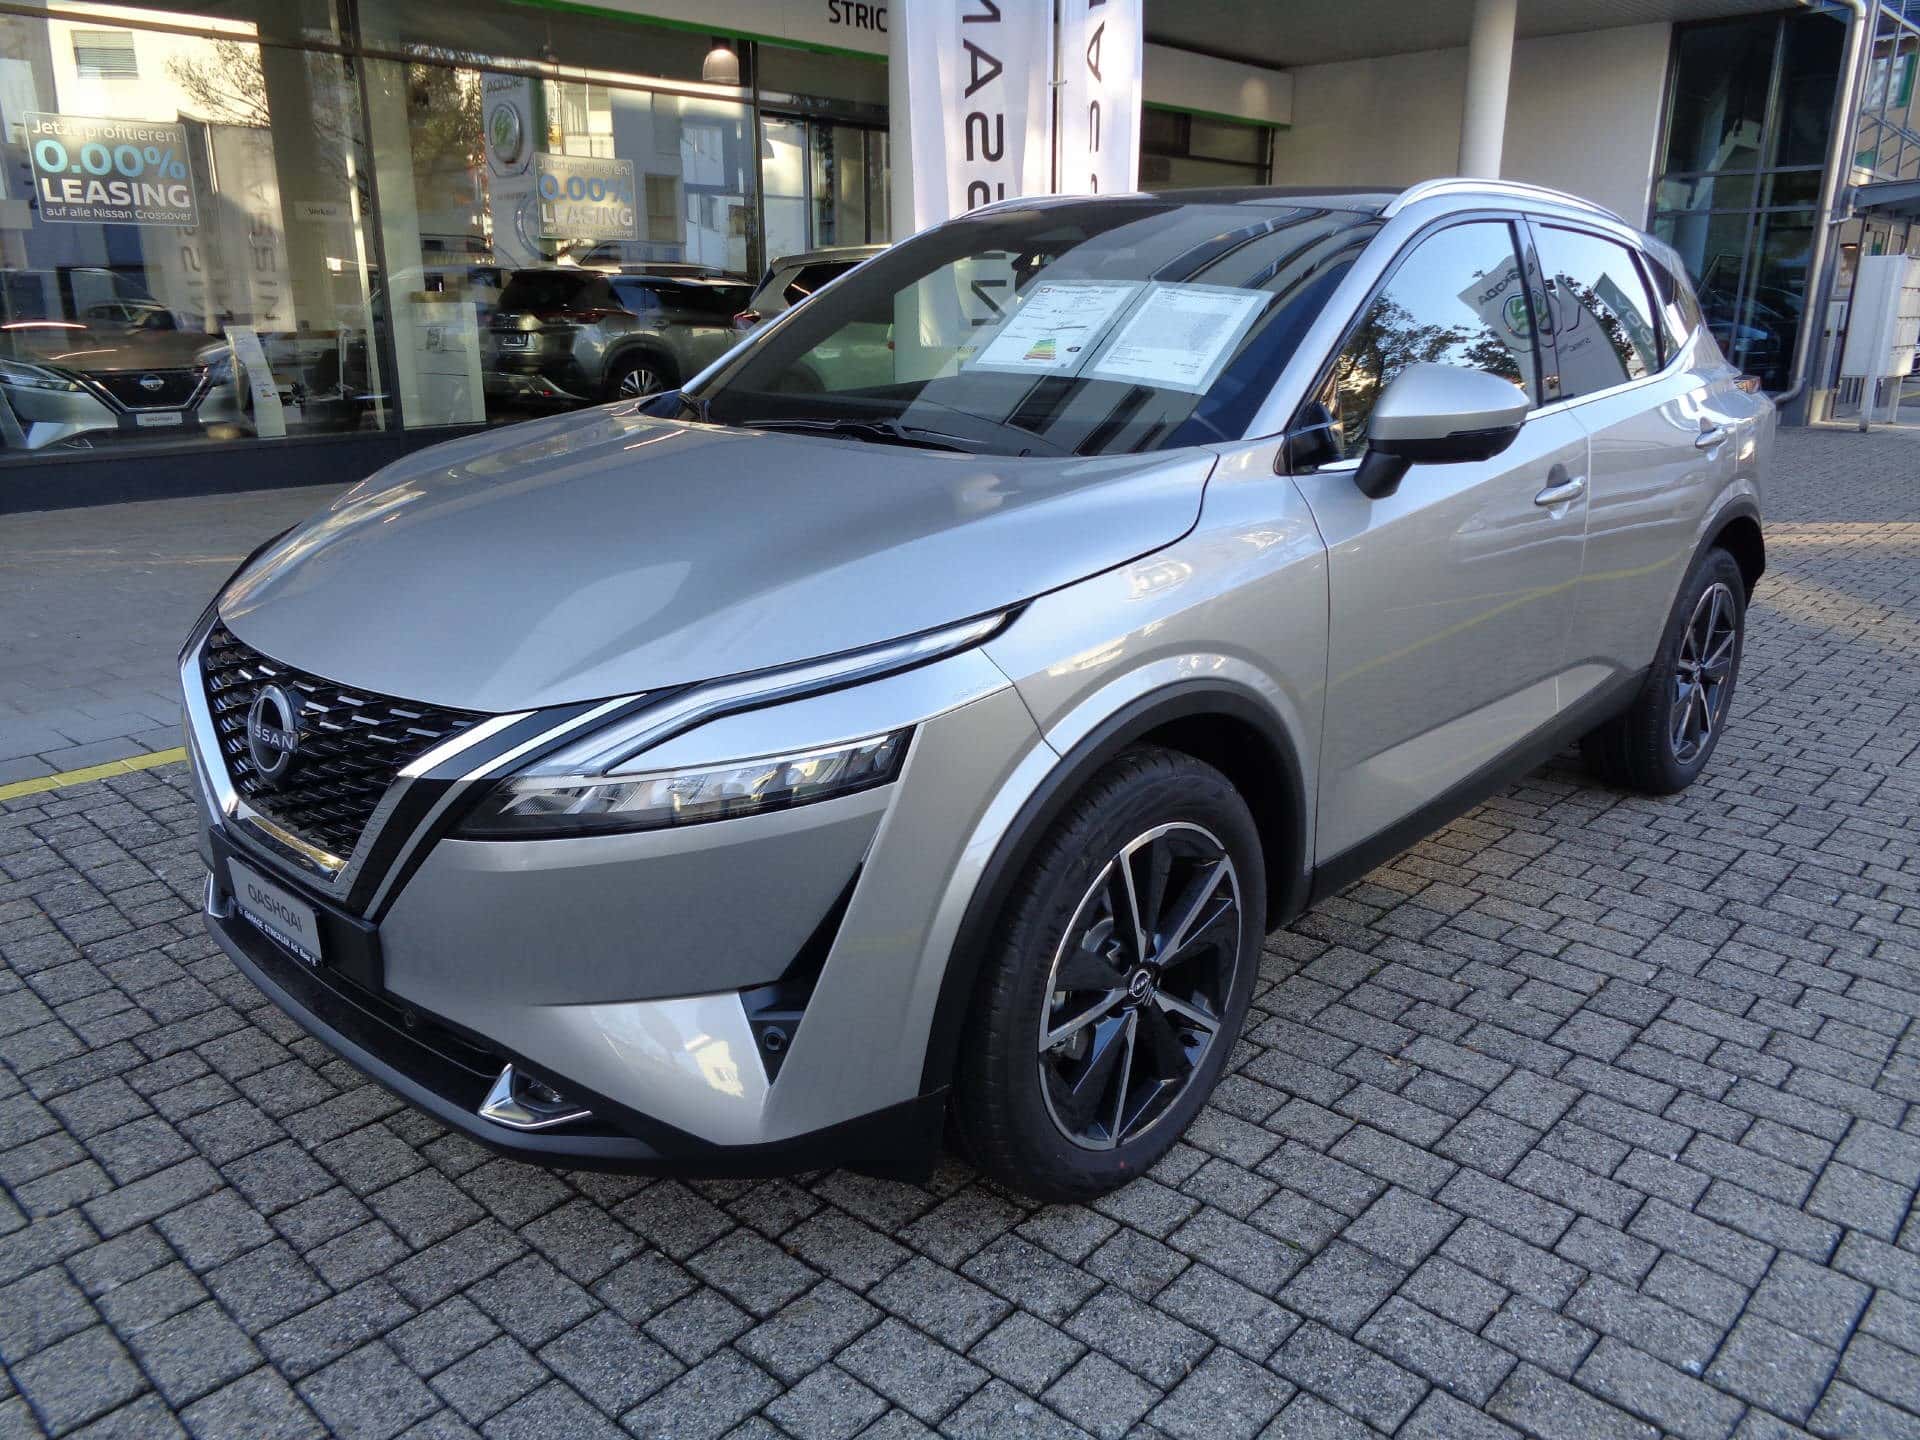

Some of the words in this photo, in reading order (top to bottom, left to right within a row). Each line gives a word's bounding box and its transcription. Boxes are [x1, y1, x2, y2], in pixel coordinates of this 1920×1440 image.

[32, 119, 77, 136] Jet
[35, 139, 186, 180] 0.00%
[41, 177, 190, 208] LEASING
[46, 207, 67, 217] auf
[70, 208, 91, 218] alle
[93, 209, 132, 219] Nissan
[135, 210, 192, 222] Crossover
